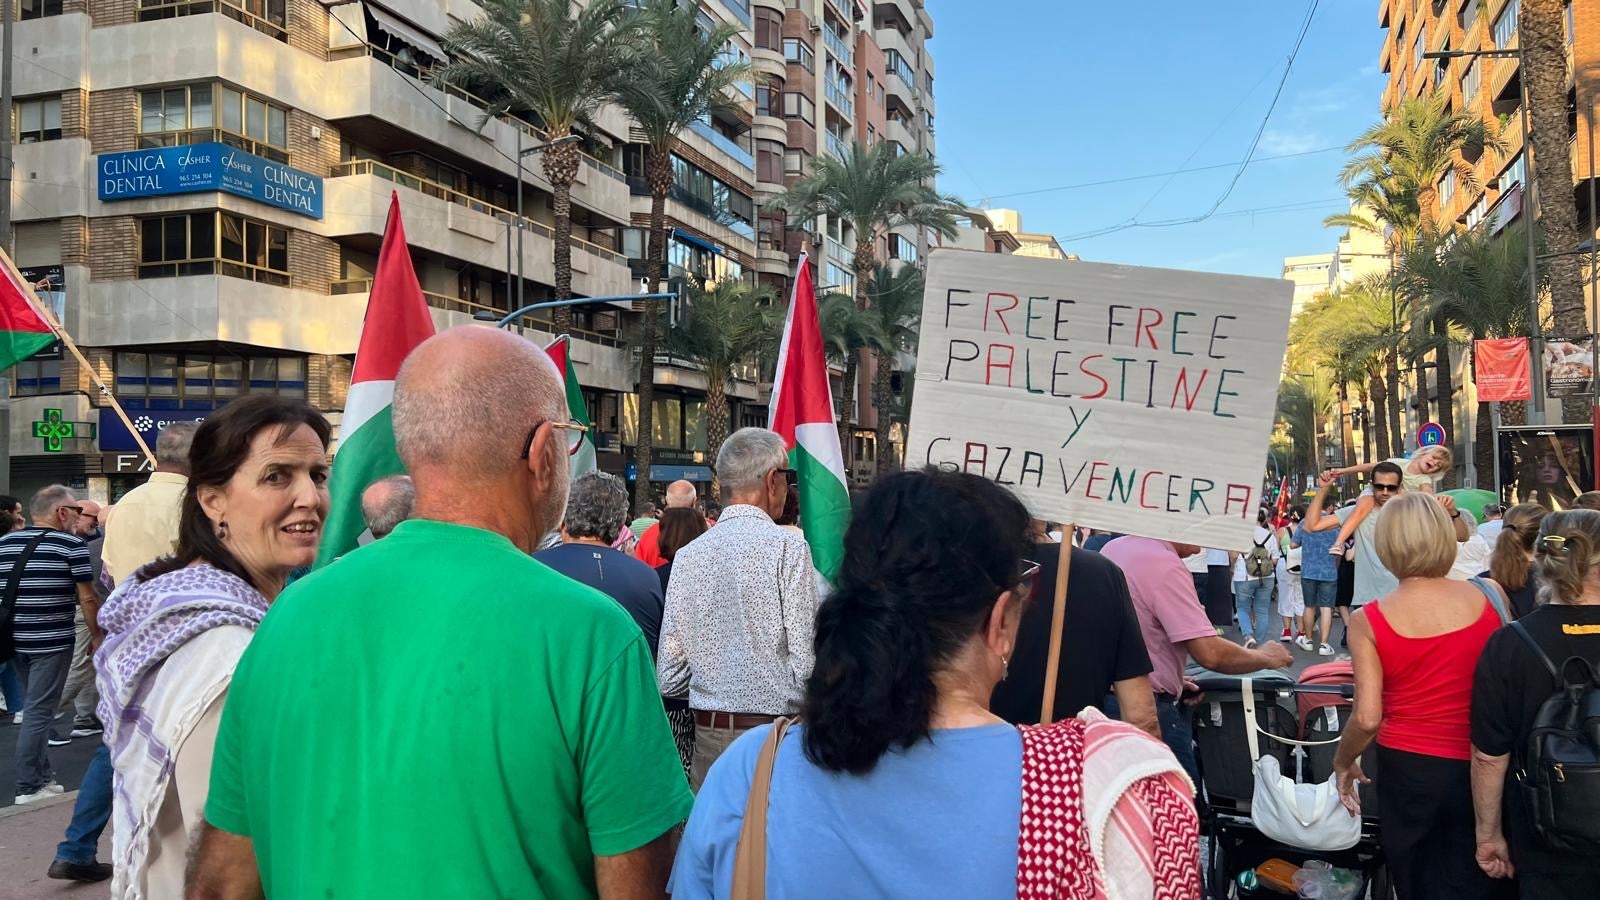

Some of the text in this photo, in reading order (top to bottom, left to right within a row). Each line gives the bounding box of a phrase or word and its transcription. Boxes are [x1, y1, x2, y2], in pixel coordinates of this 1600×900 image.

[103, 155, 165, 176] CLÍNICA
[178, 148, 211, 169] CASHER
[221, 152, 252, 173] CASHER
[104, 174, 163, 195] DENTAL
[264, 166, 316, 195] CLÍNICA
[264, 184, 314, 212] DENTAL
[946, 288, 1238, 360] FREE FREE
[945, 340, 1246, 419] PALESTINE
[926, 437, 1252, 520] GAZA VENCERA
